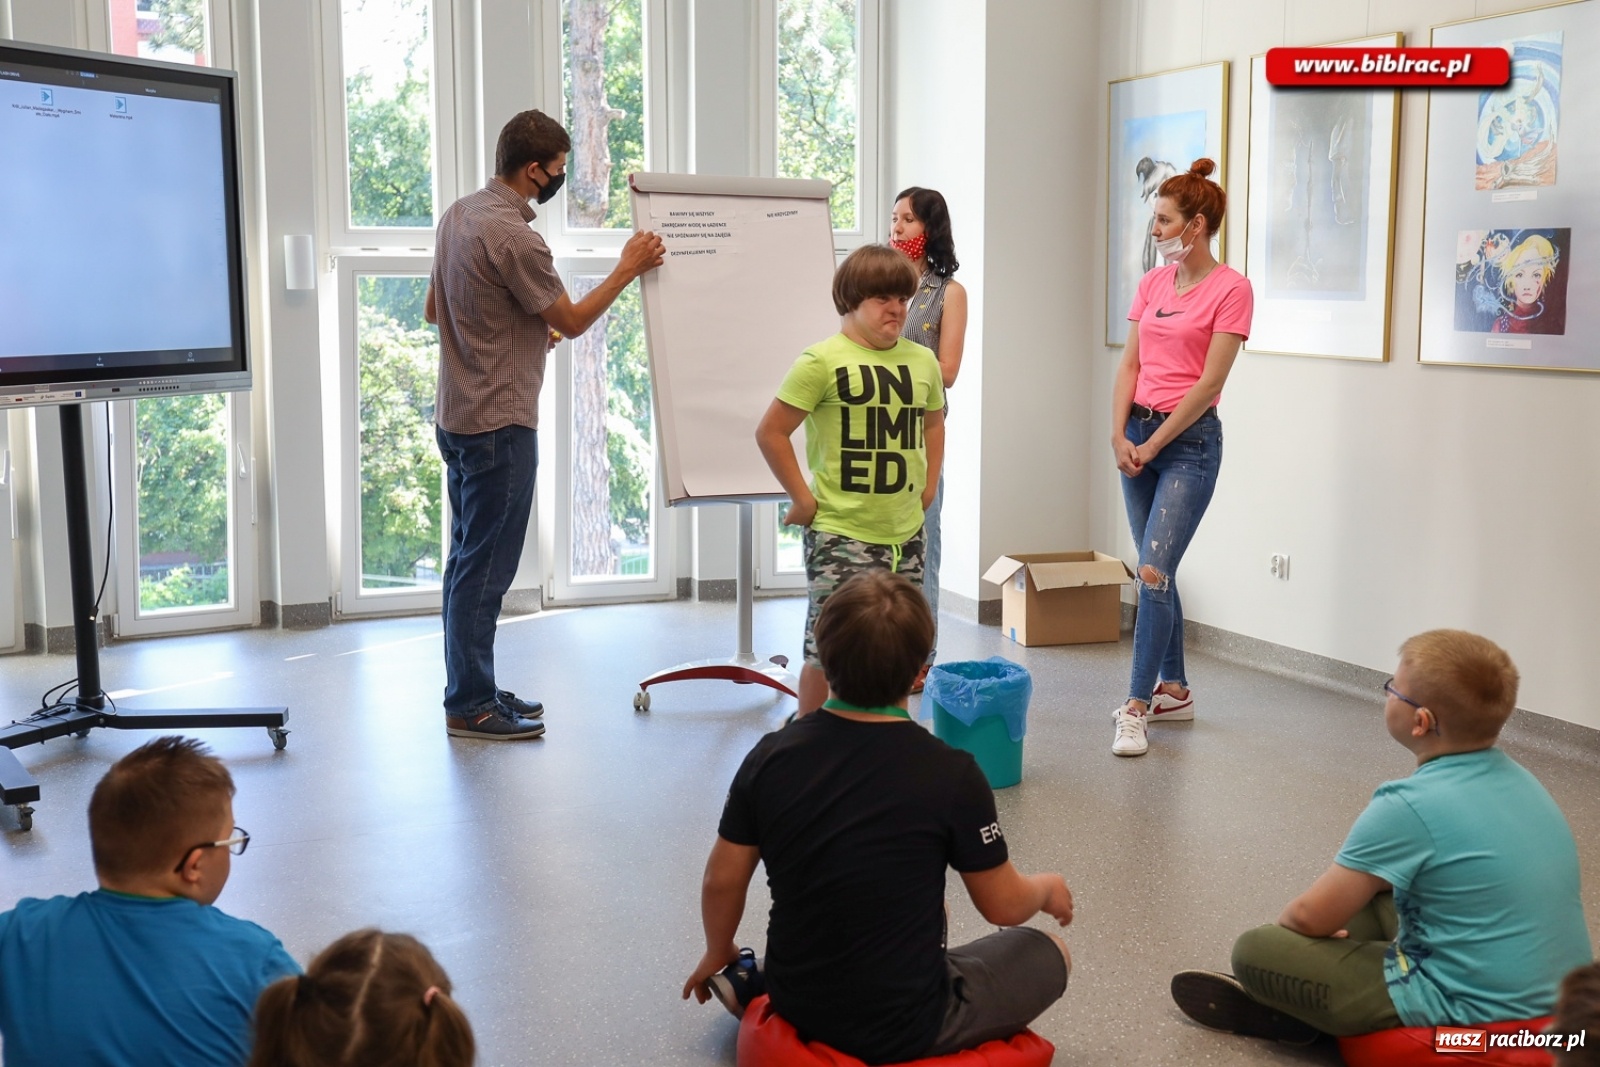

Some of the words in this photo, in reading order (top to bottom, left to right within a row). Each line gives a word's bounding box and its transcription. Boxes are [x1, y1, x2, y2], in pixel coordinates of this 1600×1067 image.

[835, 365, 913, 406] UN
[840, 406, 925, 450] LIMIT
[840, 450, 914, 495] ED.
